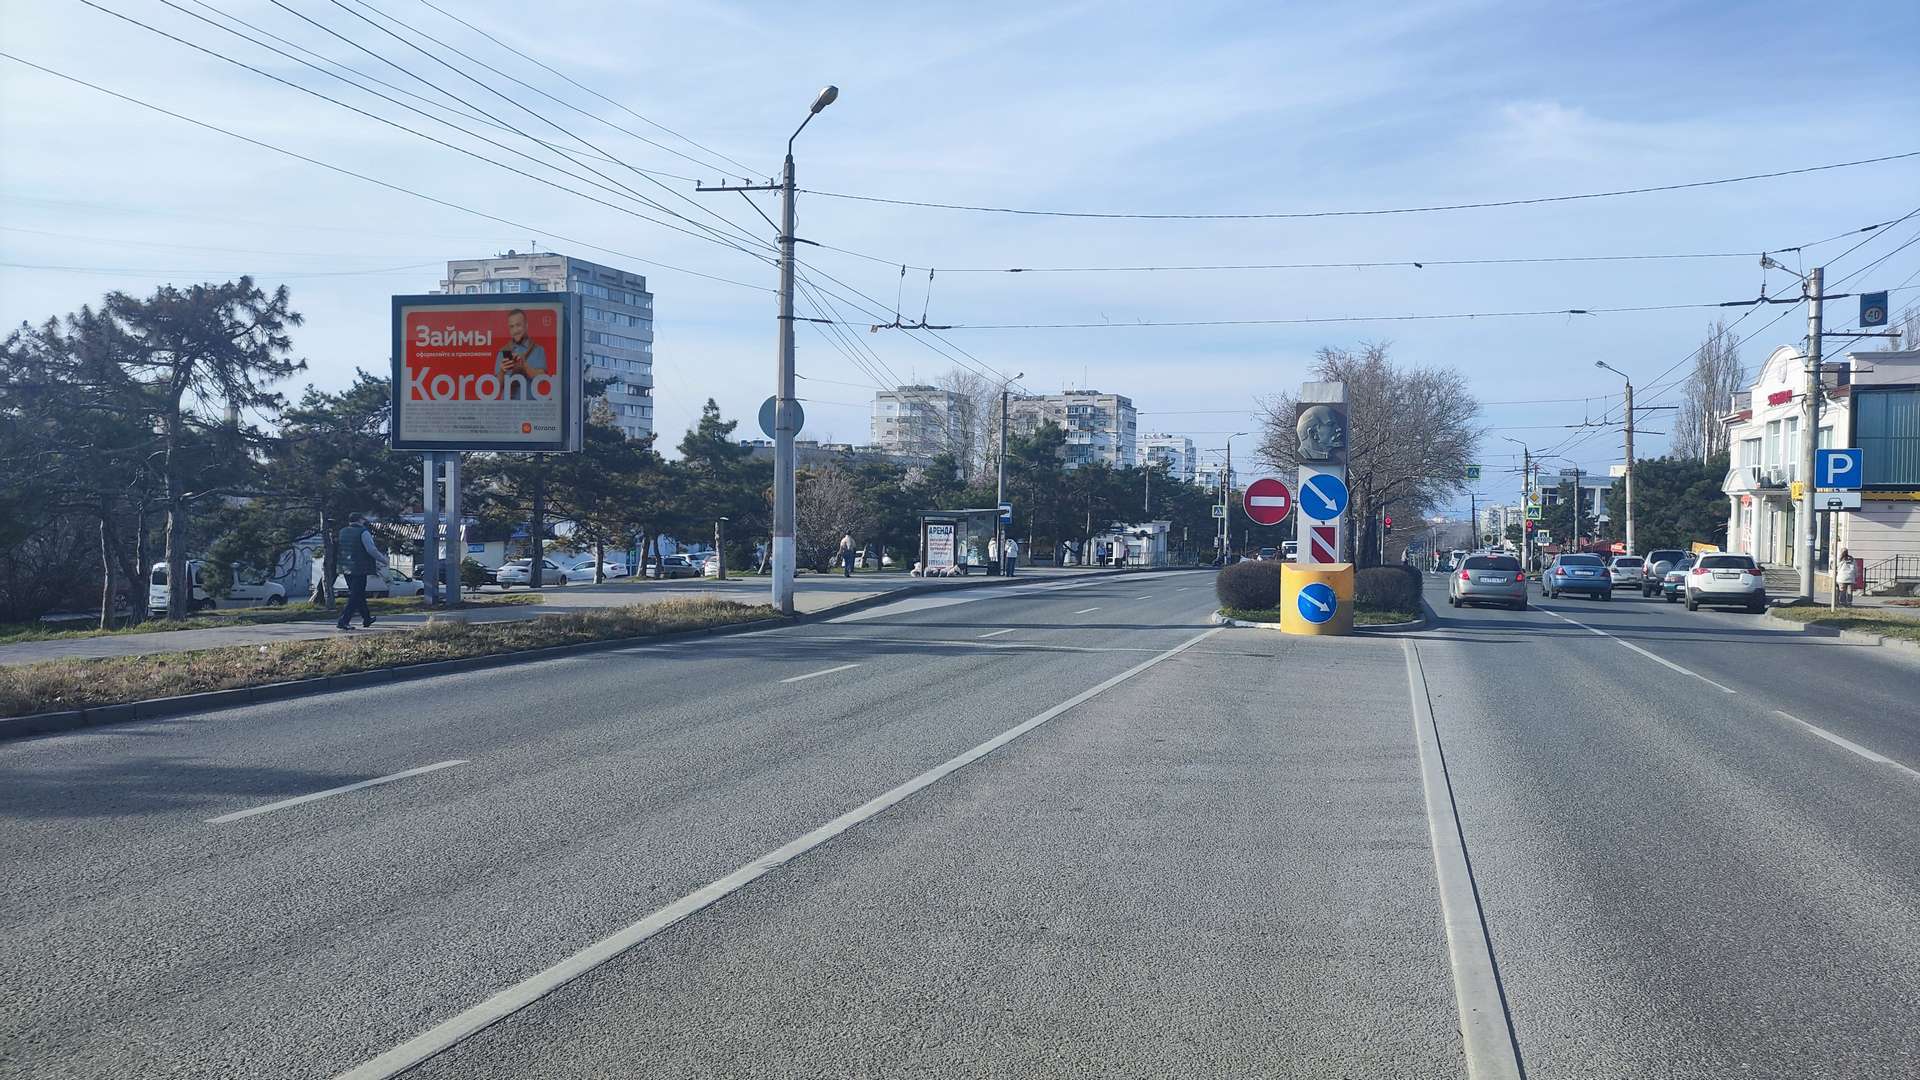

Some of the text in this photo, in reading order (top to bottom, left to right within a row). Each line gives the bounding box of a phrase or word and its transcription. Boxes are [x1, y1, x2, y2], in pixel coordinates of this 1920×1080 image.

[1867, 310, 1880, 320] 40
[415, 325, 492, 347] Займы
[405, 367, 559, 400] Korona
[1828, 454, 1853, 484] P
[929, 527, 952, 535] АРЕНДА
